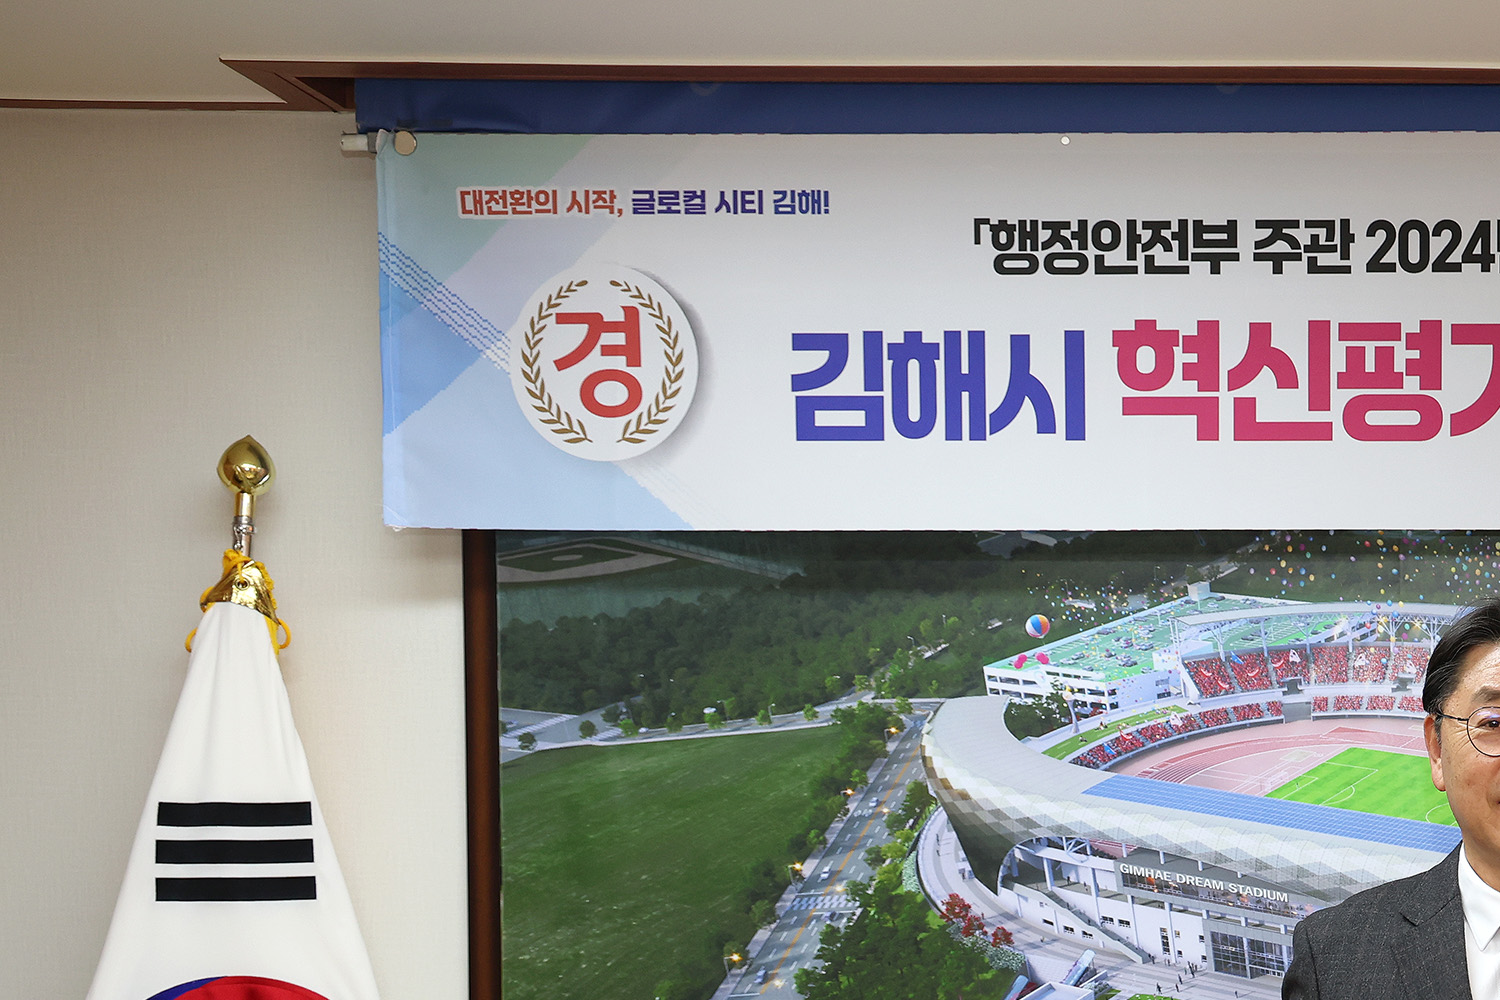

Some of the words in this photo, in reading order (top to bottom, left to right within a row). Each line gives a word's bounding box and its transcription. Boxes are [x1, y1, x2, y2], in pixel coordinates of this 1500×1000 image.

[459, 189, 558, 216] 대전환의
[566, 189, 623, 218] 시작,
[631, 189, 707, 215] 글로컬
[714, 189, 764, 215] 시티
[772, 189, 830, 215] 김해!
[973, 217, 1240, 276] 「행정안전부
[1252, 218, 1356, 275] 주관
[553, 305, 643, 419] 경
[790, 329, 1086, 442] 김해시
[1119, 863, 1172, 882] GIMHAE
[1176, 872, 1225, 891] DREAM
[1228, 882, 1289, 903] STADIUM
